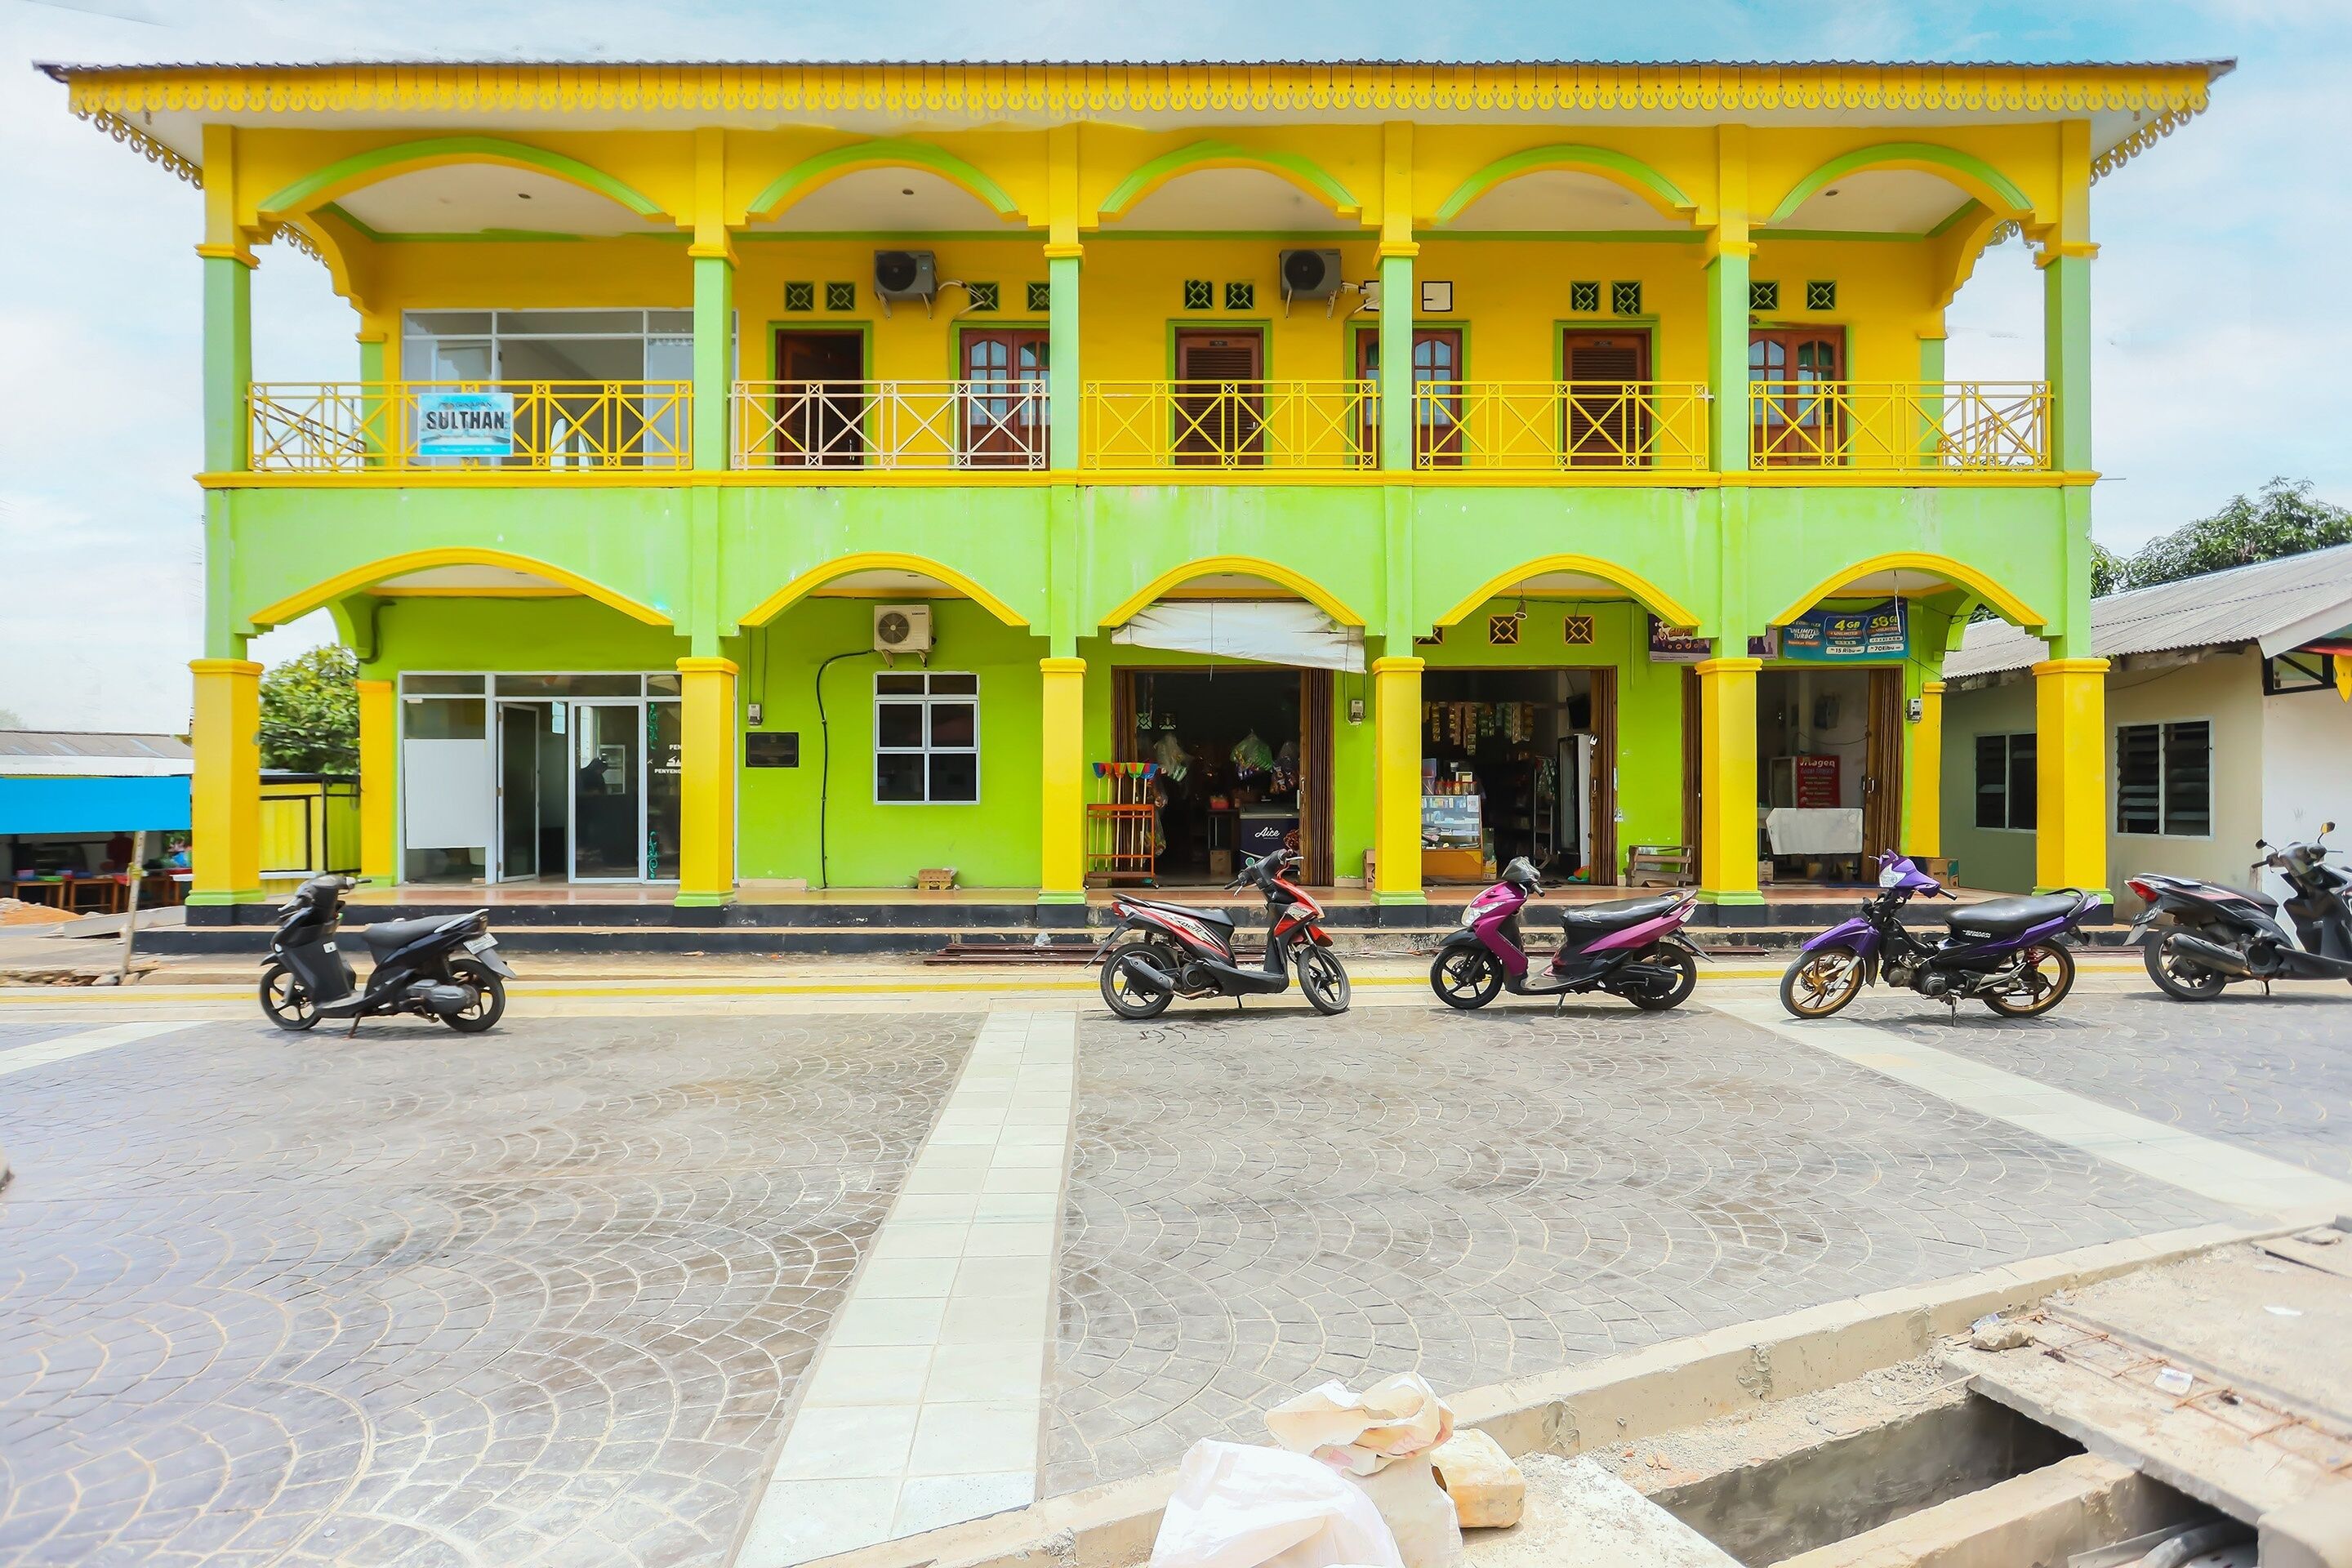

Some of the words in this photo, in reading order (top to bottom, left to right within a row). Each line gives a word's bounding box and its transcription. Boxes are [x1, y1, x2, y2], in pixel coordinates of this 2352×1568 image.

[426, 411, 505, 430] SULTHAN
[1834, 620, 1846, 630] 4
[1846, 621, 1860, 629] GB
[1254, 826, 1281, 838] Aice
